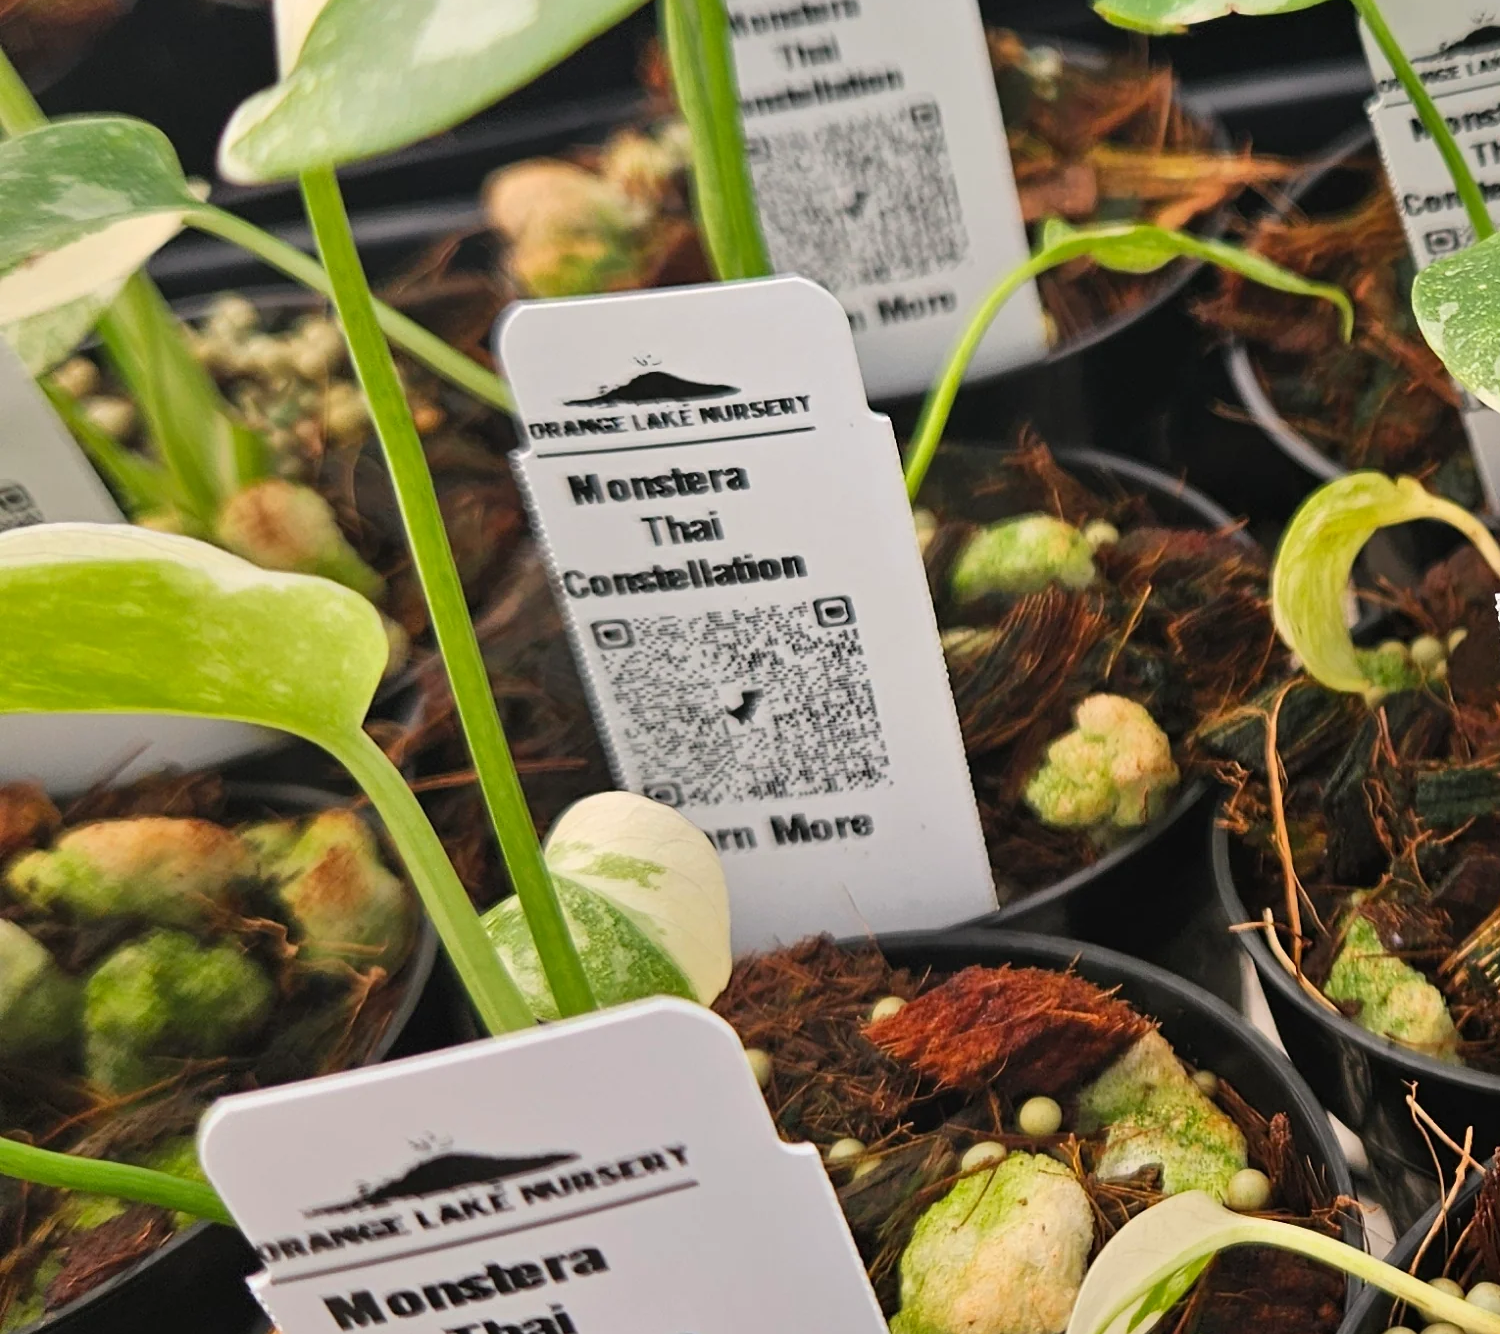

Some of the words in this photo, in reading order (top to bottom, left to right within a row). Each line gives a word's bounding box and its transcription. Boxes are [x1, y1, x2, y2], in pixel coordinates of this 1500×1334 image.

[878, 292, 957, 328] More
[529, 415, 627, 440] ORANGE
[631, 403, 694, 431] LAKE
[700, 394, 811, 424] NURSERY
[567, 462, 750, 506] Monstera
[641, 510, 724, 547] Thai
[563, 551, 808, 600] Constellation
[769, 810, 874, 849] More
[257, 1214, 412, 1263] ORANGE
[416, 1184, 512, 1230] LAKE
[521, 1145, 689, 1205] NURSERY
[322, 1242, 611, 1334] Monstera
